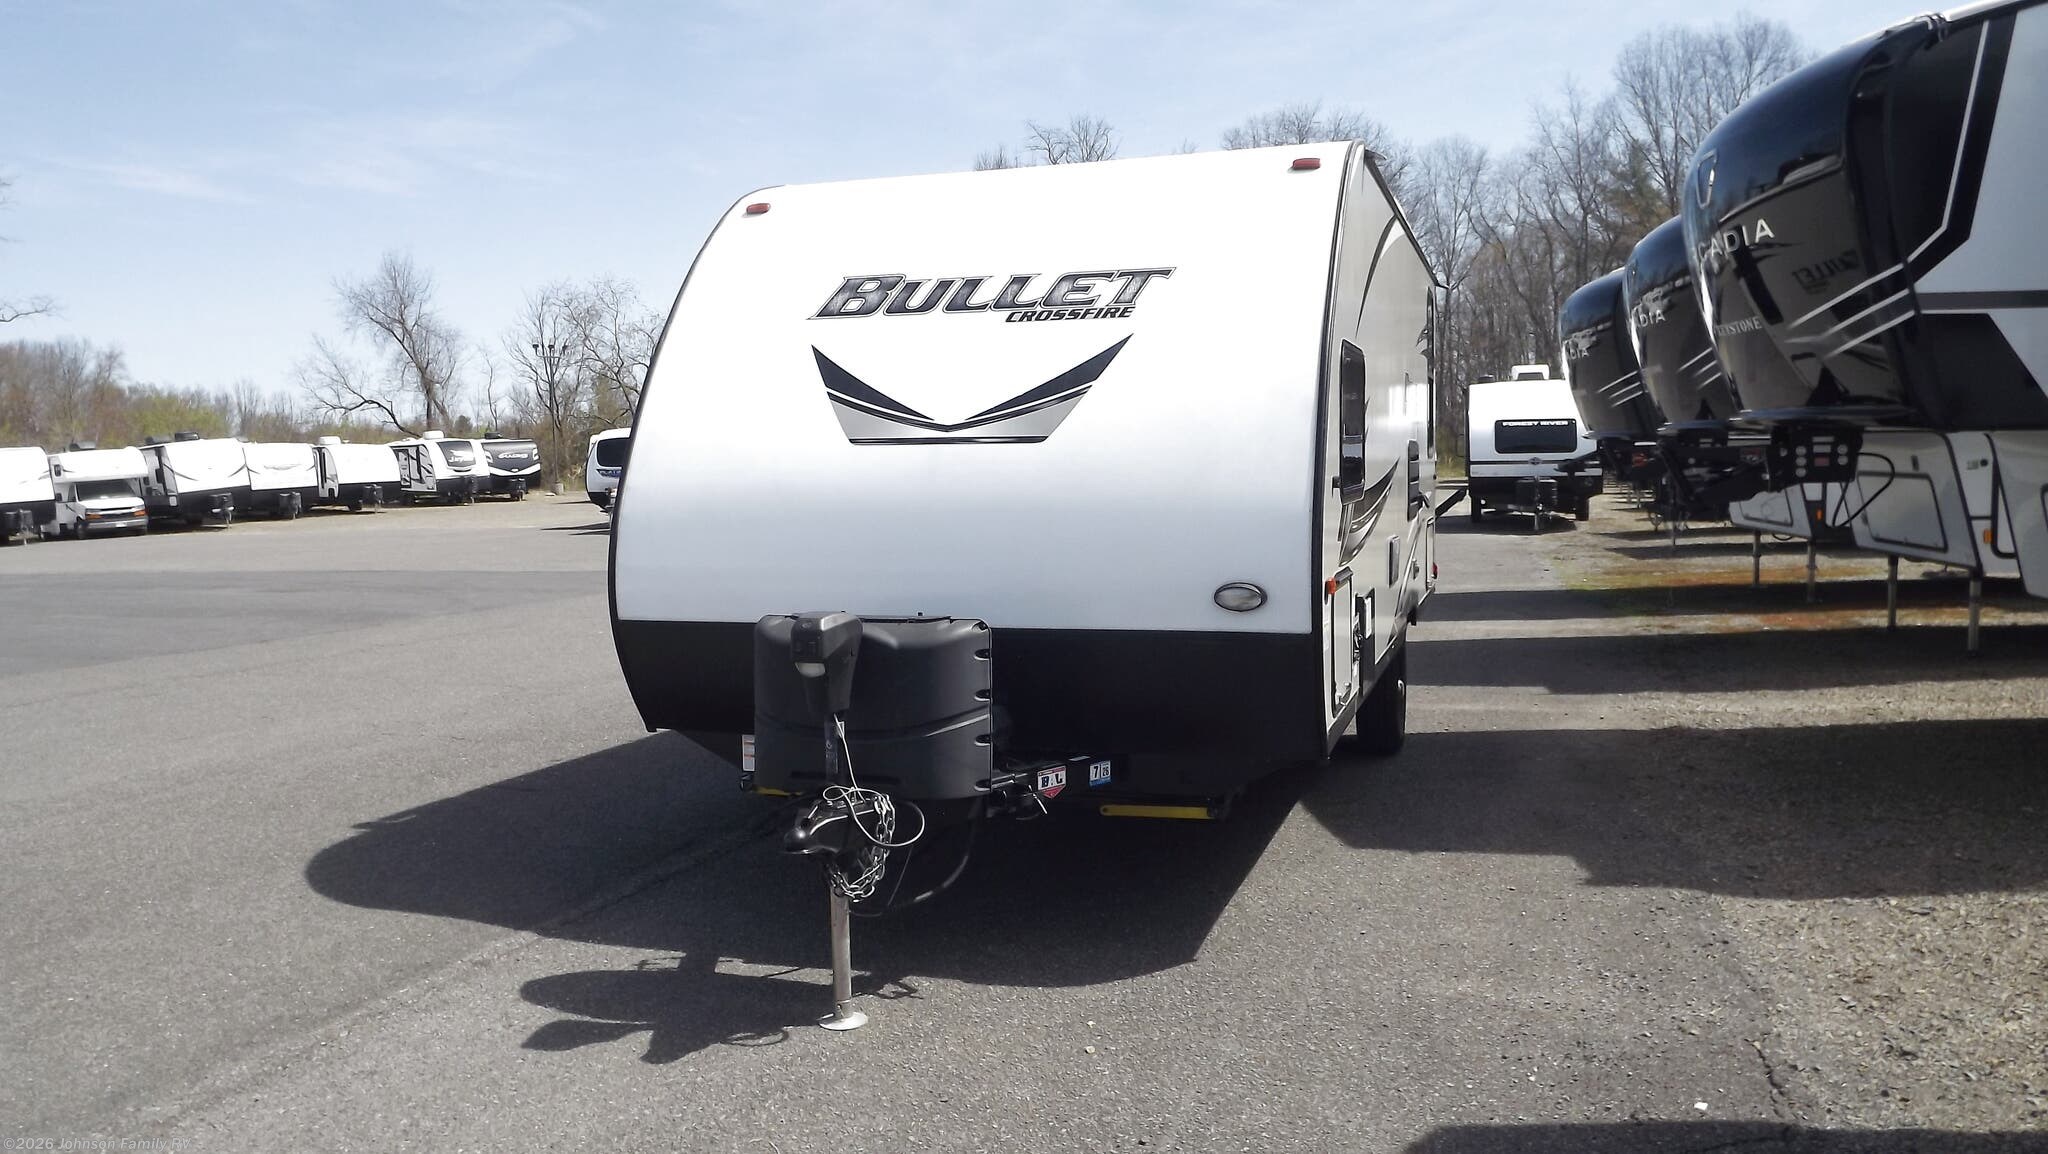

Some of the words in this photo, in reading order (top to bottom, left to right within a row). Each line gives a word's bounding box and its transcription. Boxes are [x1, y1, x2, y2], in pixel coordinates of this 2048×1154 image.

[806, 267, 1177, 321] BULLET
[1005, 306, 1136, 323] CROSSFIRE
[1093, 766, 1099, 778] 7
